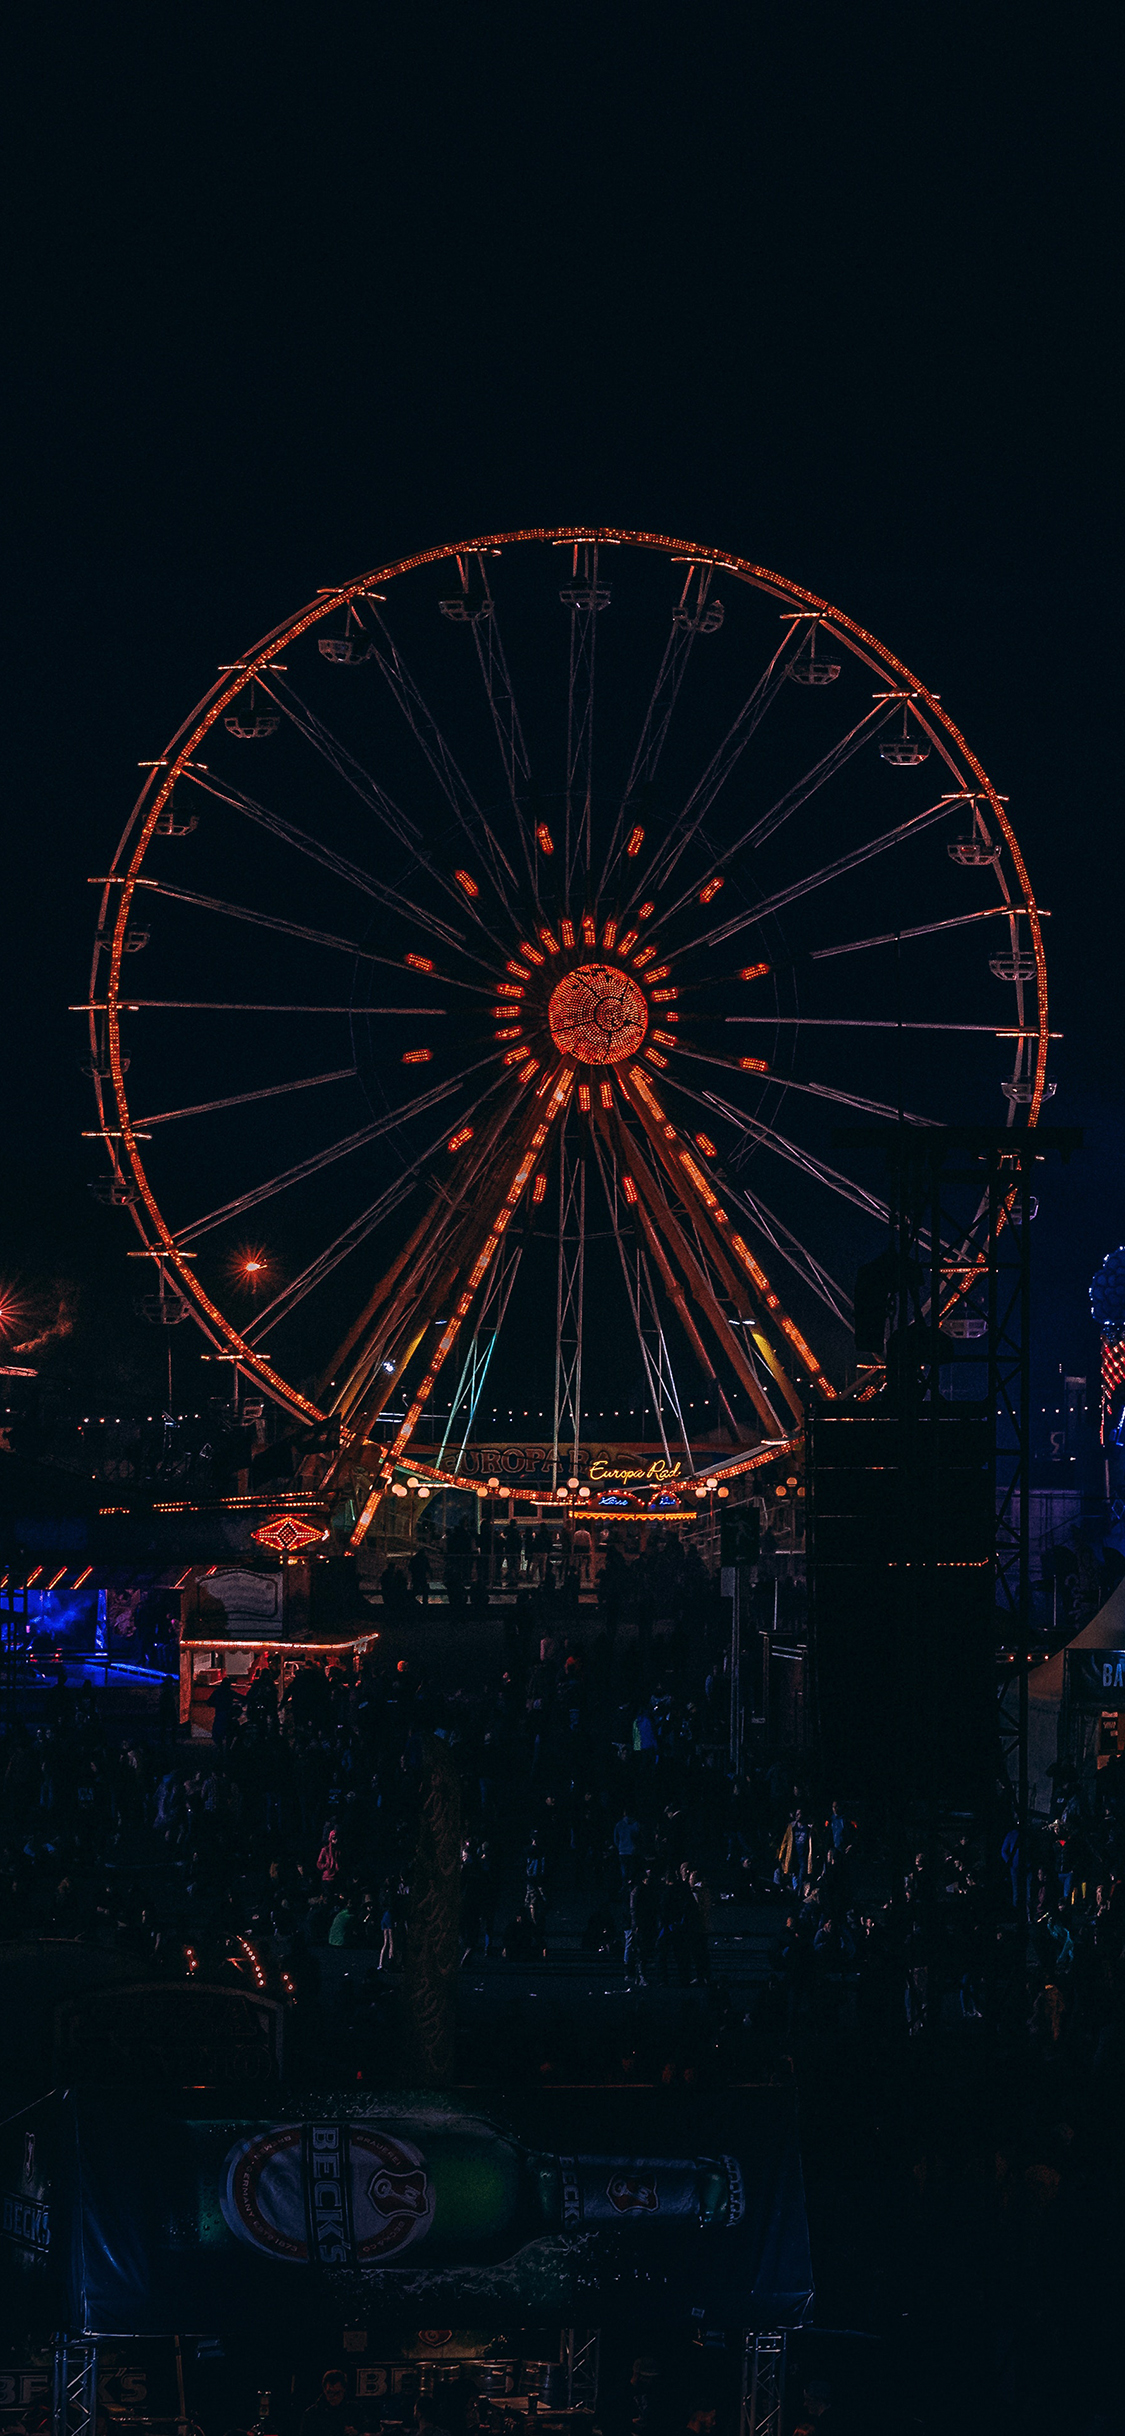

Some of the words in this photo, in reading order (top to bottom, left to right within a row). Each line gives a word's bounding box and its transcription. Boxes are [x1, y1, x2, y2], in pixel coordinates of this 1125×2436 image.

[440, 1447, 564, 1476] EUROPA
[589, 1460, 646, 1485] Europa
[646, 1459, 682, 1482] Rad
[241, 2166, 255, 2217] GERMANY
[312, 2127, 352, 2264] BECK'S
